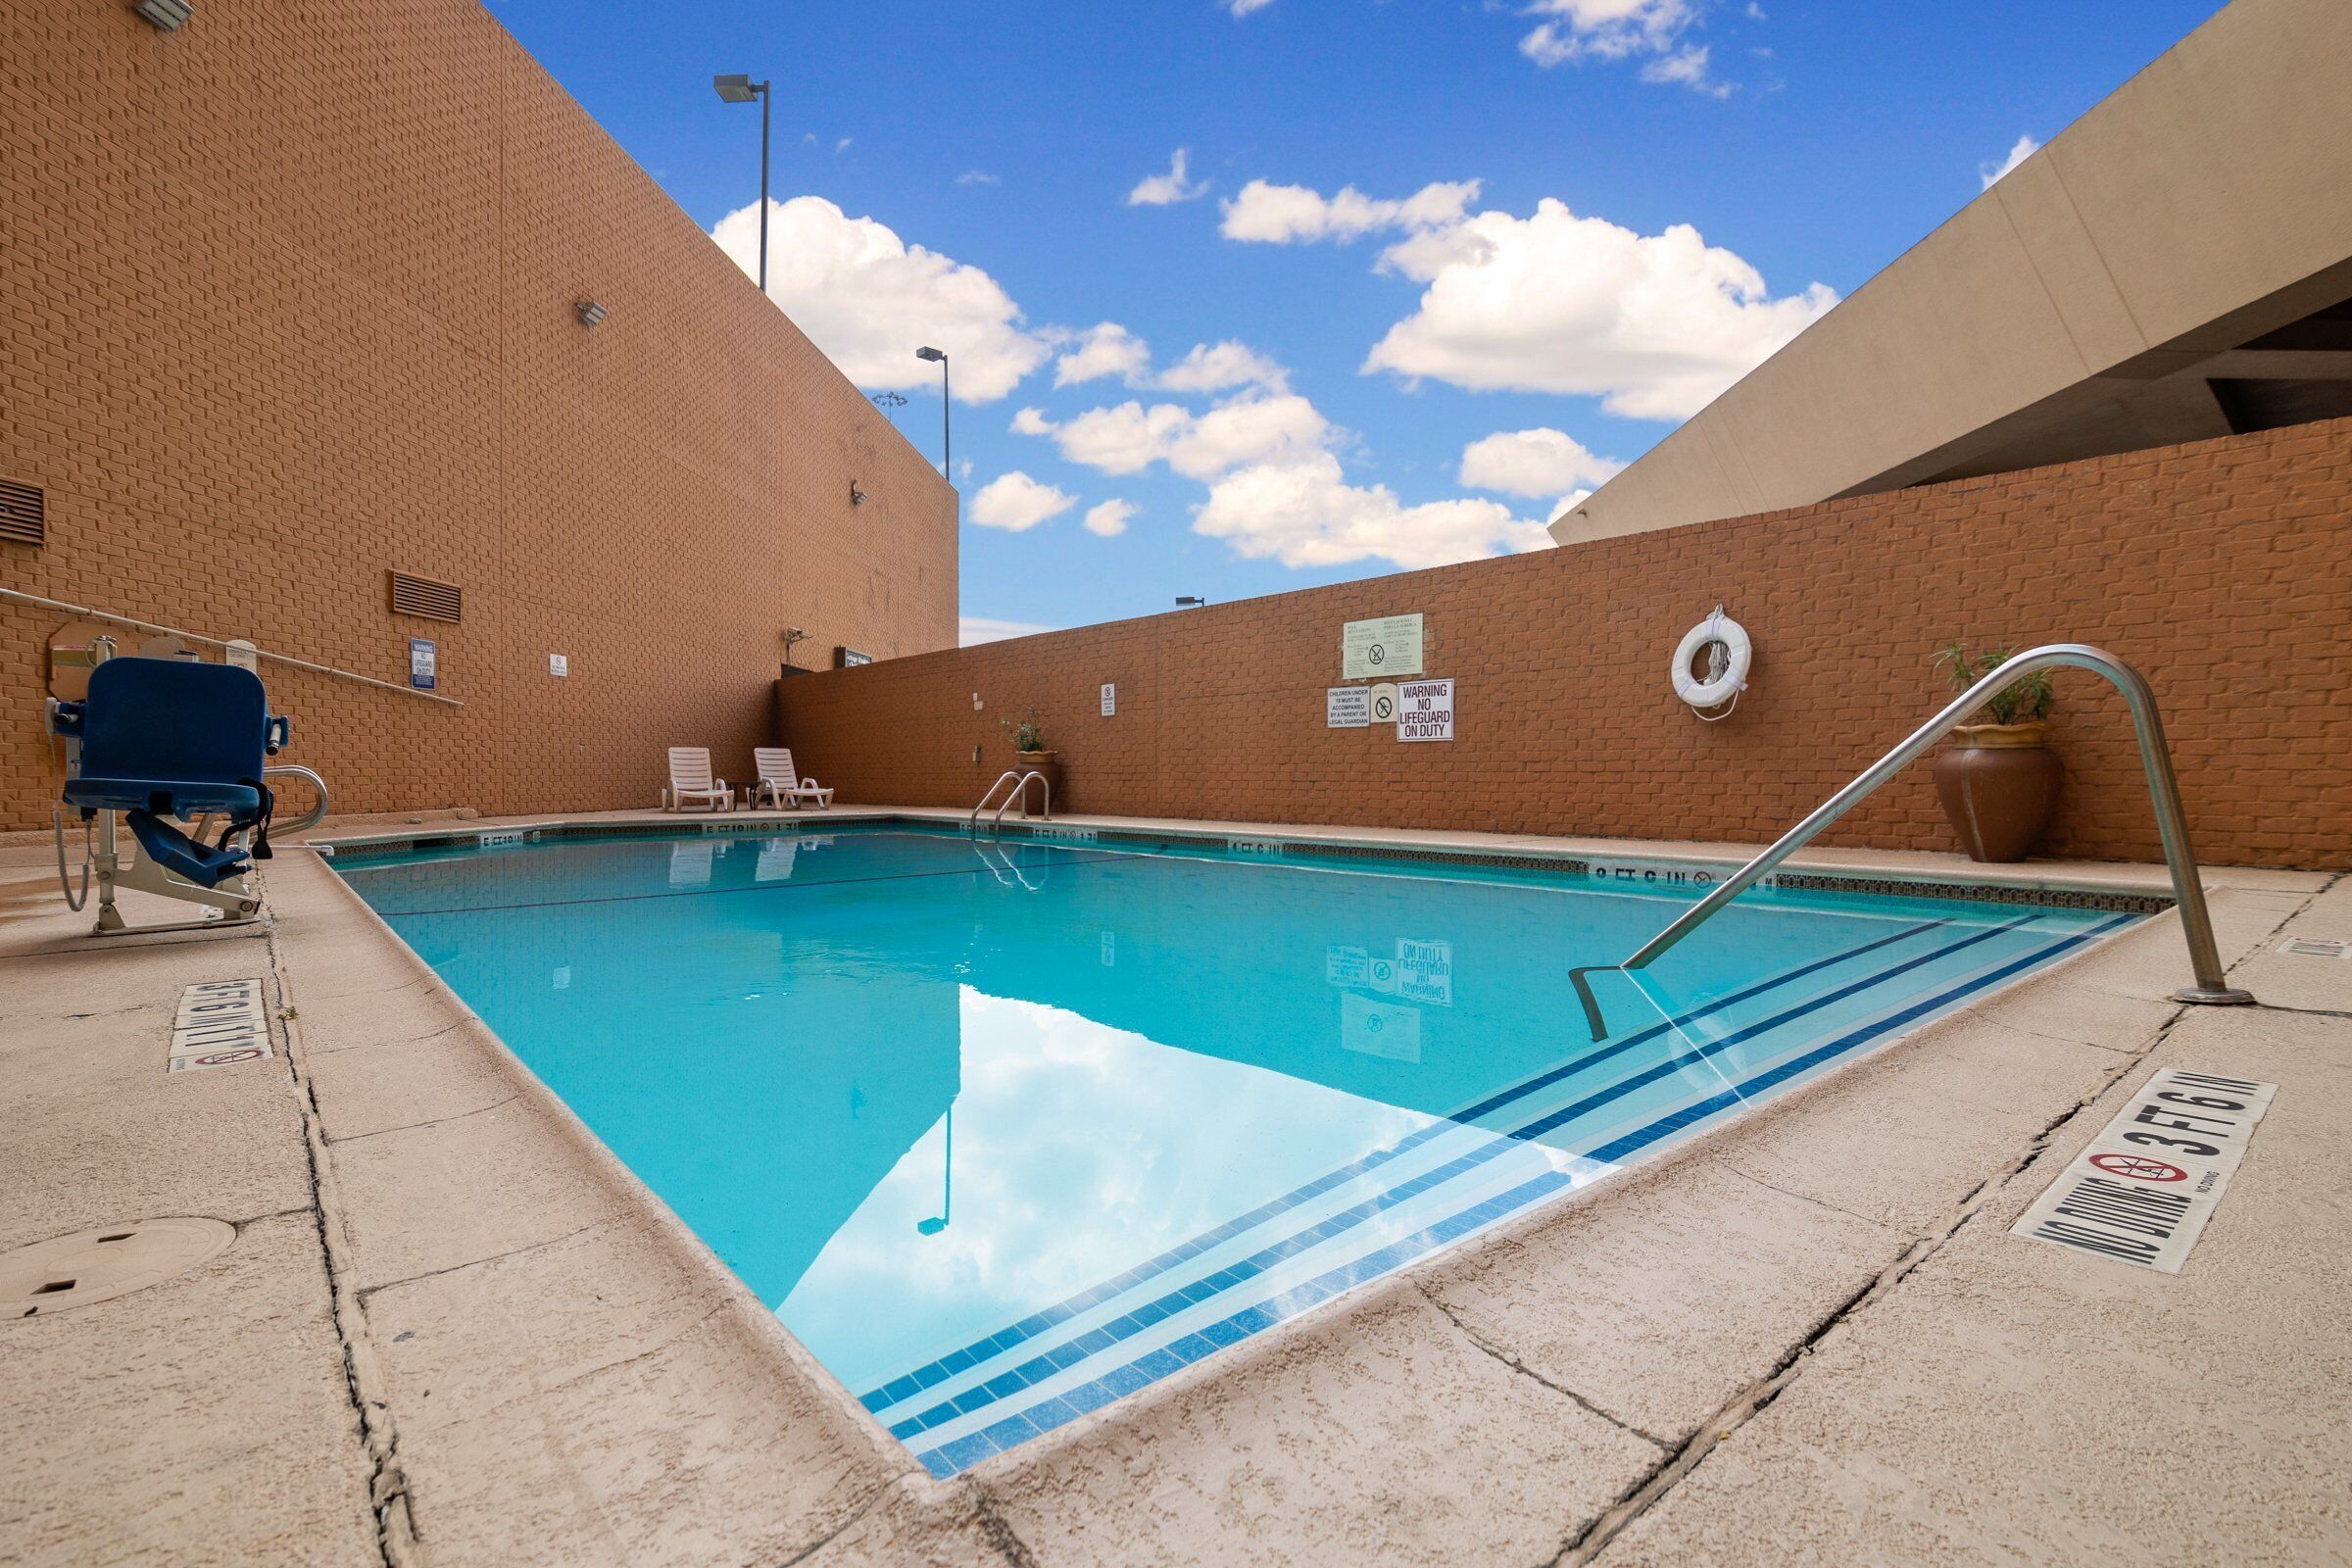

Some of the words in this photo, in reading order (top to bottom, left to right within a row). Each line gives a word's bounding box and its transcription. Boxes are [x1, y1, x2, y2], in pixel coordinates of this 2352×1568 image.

[415, 644, 433, 654] WARNING
[1403, 684, 1447, 699] WARNING
[1417, 698, 1431, 710] NO
[1399, 710, 1450, 724] LIFEGUARD
[1404, 724, 1418, 737] ON
[1420, 723, 1446, 736] DUTY
[2169, 1071, 2260, 1096] IN
[2157, 1091, 2245, 1110] 6
[2134, 1104, 2236, 1138] FT
[2123, 1132, 2221, 1156] 3
[2201, 1170, 2220, 1187] DIVING
[2195, 1183, 2210, 1194] NO
[2054, 1177, 2192, 1239] DIVING
[2033, 1220, 2161, 1264] NO
